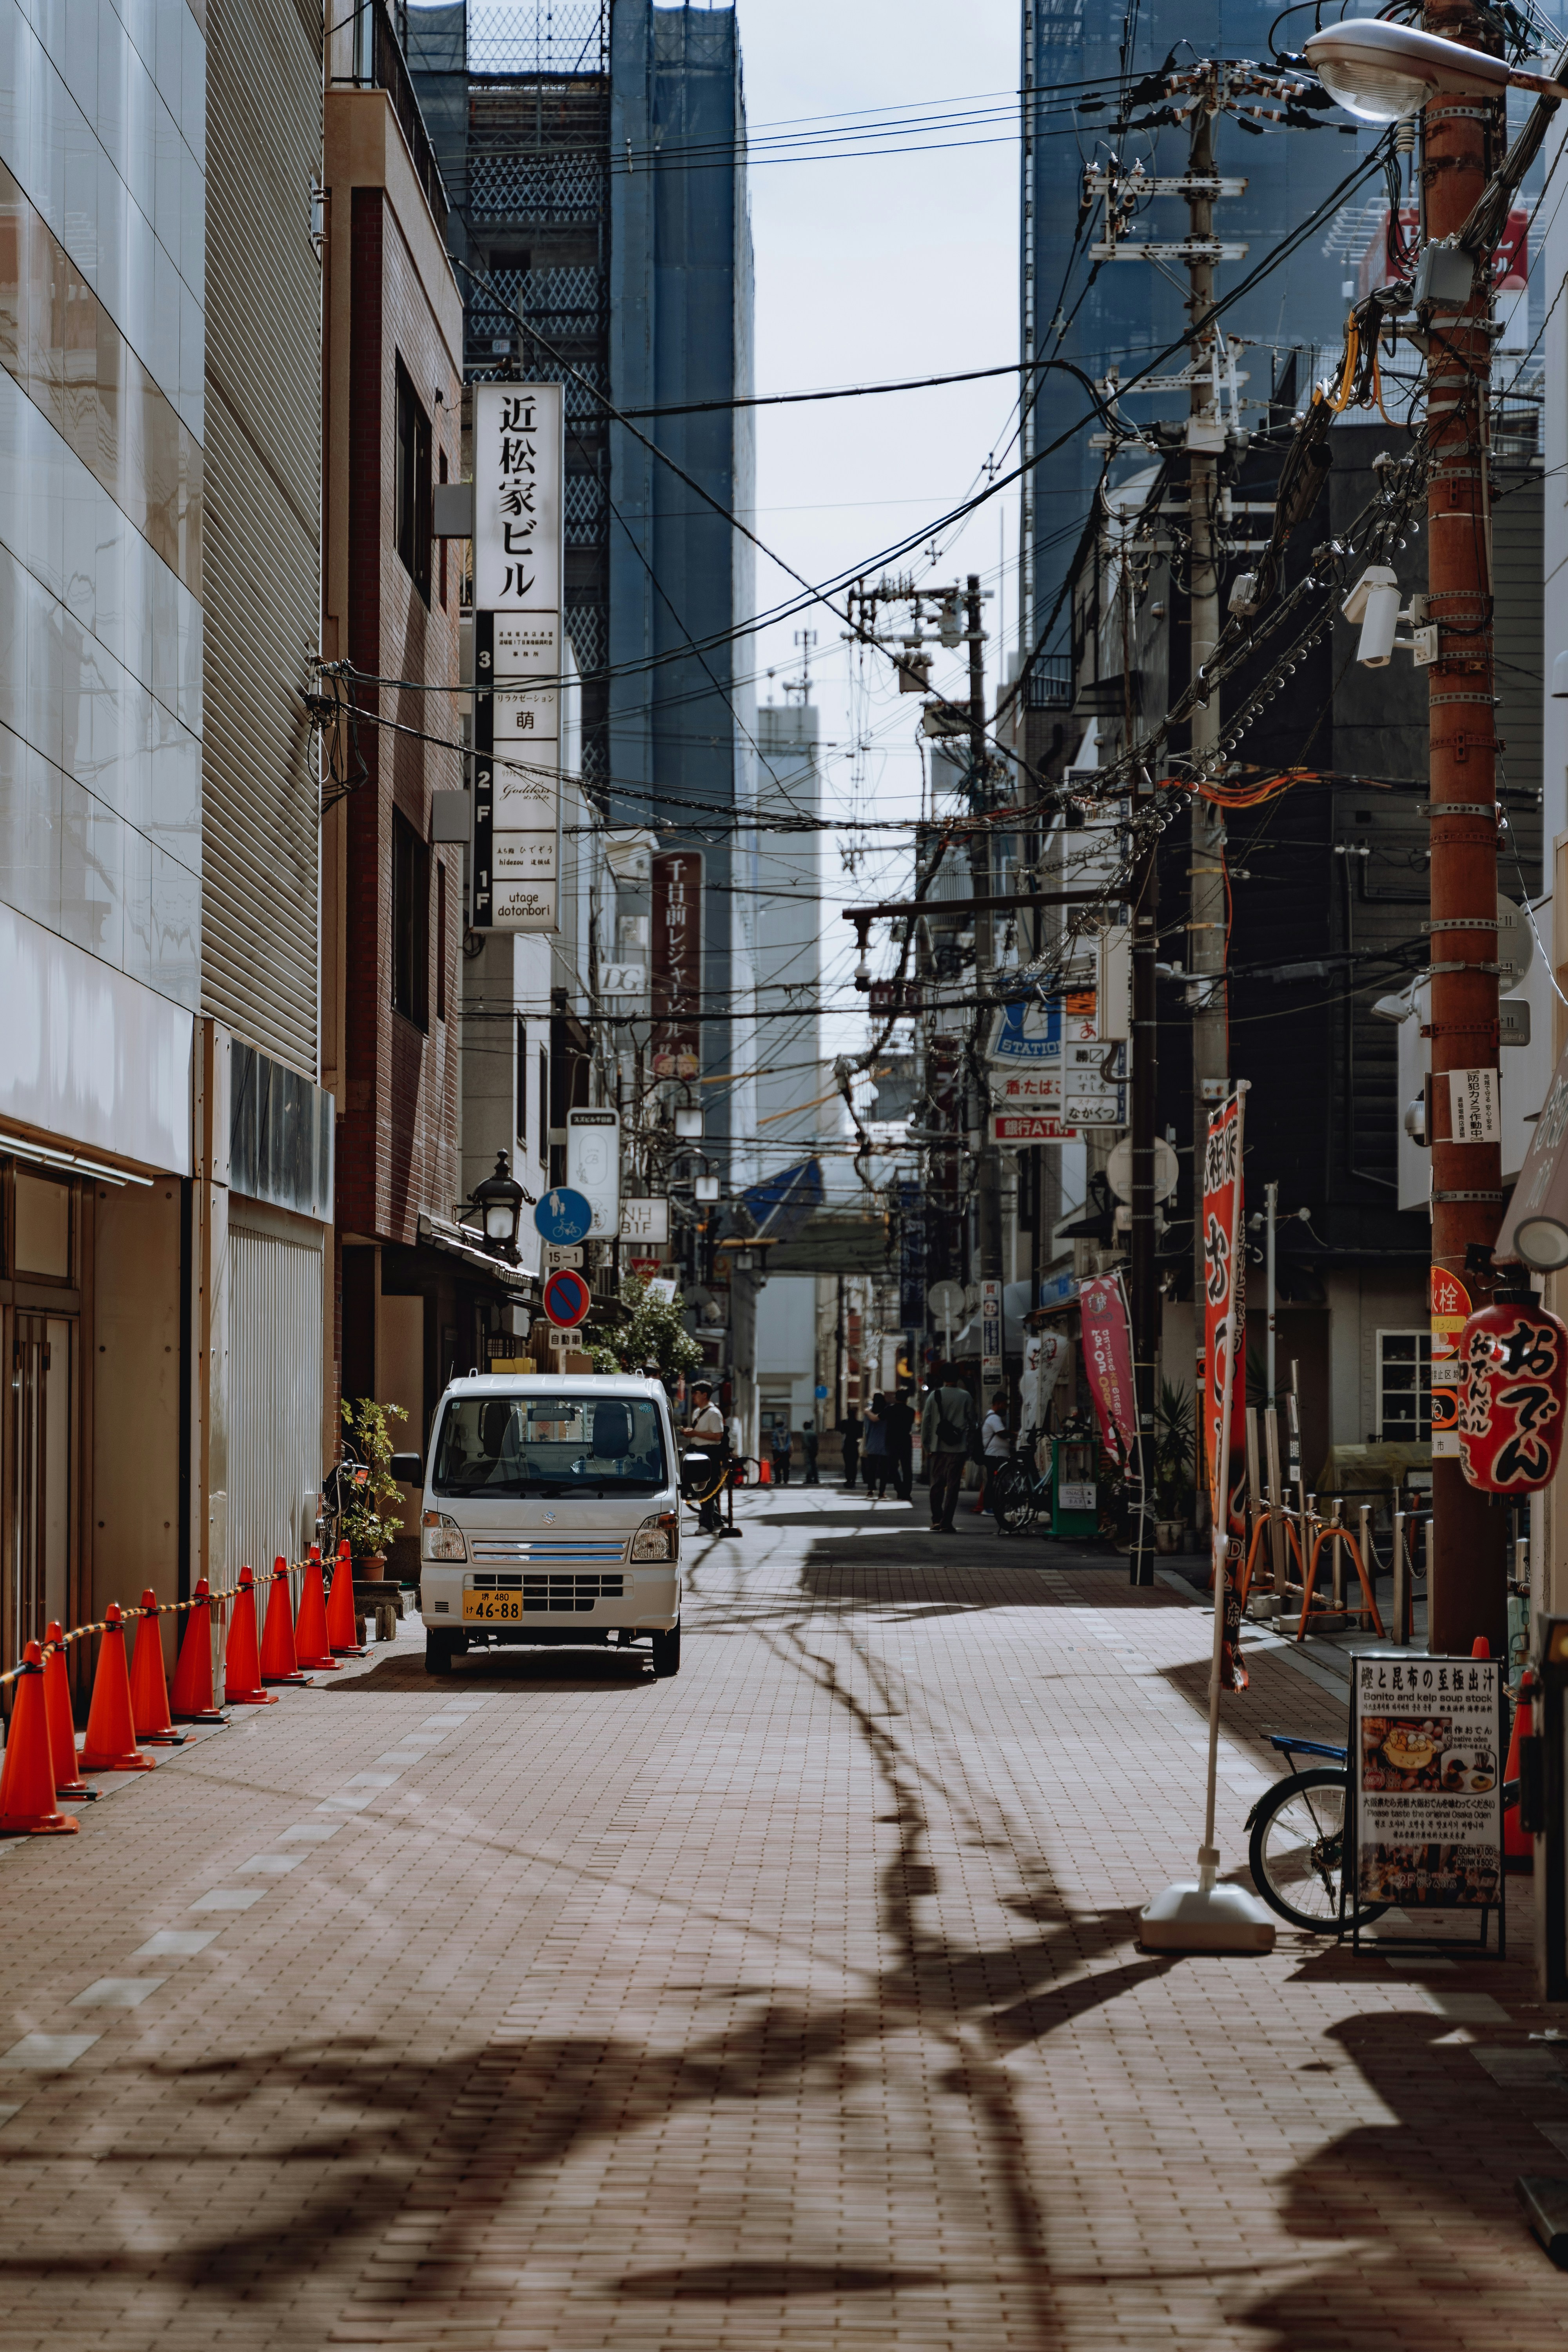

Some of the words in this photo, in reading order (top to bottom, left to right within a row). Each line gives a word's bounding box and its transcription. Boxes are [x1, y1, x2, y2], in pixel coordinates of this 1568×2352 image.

[499, 395, 538, 597] 近松家ビル
[516, 711, 534, 729] 萌
[499, 781, 550, 800] Goddess
[520, 845, 553, 854] ひでぞう
[509, 892, 539, 906] utage
[497, 904, 550, 916] dotonbori
[1467, 1074, 1483, 1137] 防犯カメラ作動中
[1004, 1119, 1069, 1136] 銀行ATM
[621, 1221, 652, 1234] B1F
[551, 1334, 581, 1346] 自動車
[1495, 1321, 1555, 1483] おでん
[481, 1593, 490, 1601] 堺
[475, 1602, 519, 1618] 46-88
[1361, 1666, 1495, 1693] 鰹と昆布の至極出汁
[1363, 1692, 1395, 1702] Bonito
[1397, 1693, 1415, 1702] and
[1417, 1693, 1437, 1704] kelp
[1440, 1695, 1463, 1704] soup
[1465, 1694, 1493, 1703] stock
[1367, 1809, 1389, 1818] Please
[1425, 1810, 1450, 1820] original
[1452, 1811, 1472, 1819] Osaka
[1474, 1811, 1492, 1819] Oden
